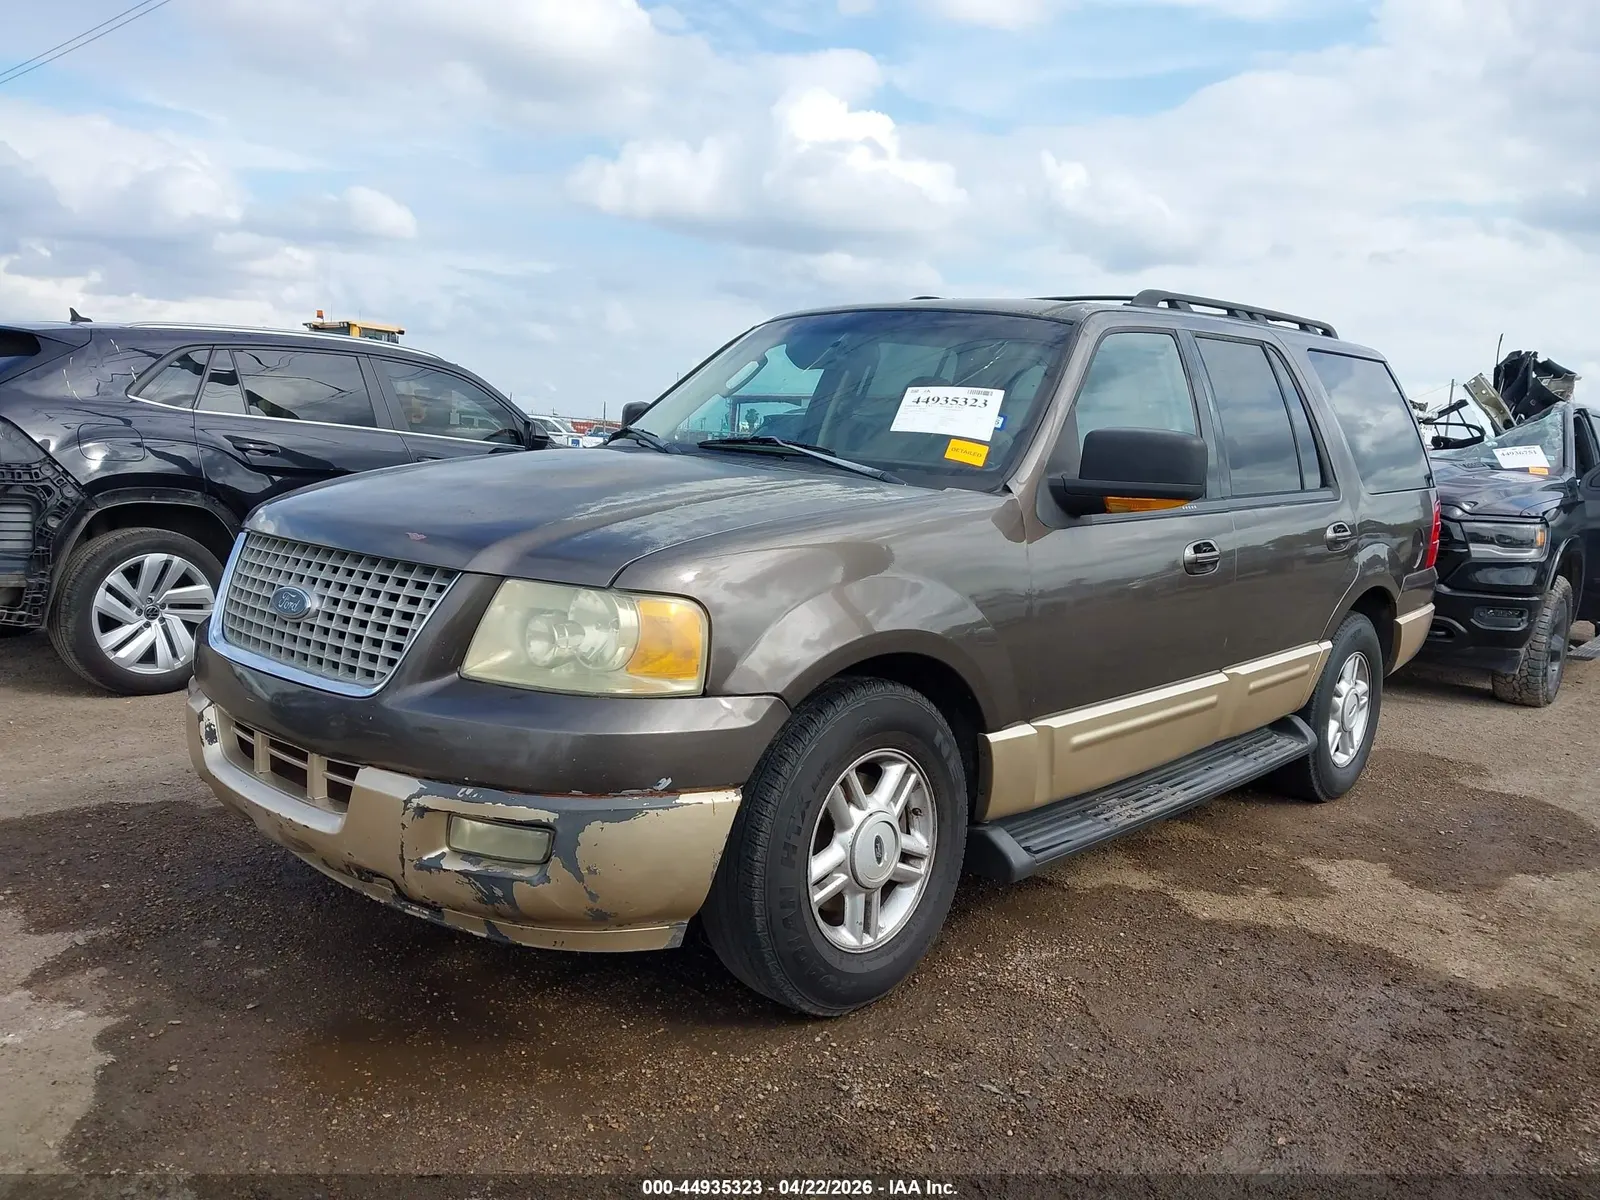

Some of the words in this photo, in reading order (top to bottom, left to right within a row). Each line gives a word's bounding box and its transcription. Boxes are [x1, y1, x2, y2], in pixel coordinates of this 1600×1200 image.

[912, 396, 988, 408] 44935323
[951, 447, 982, 458] DETAILED
[278, 591, 301, 612] Ford
